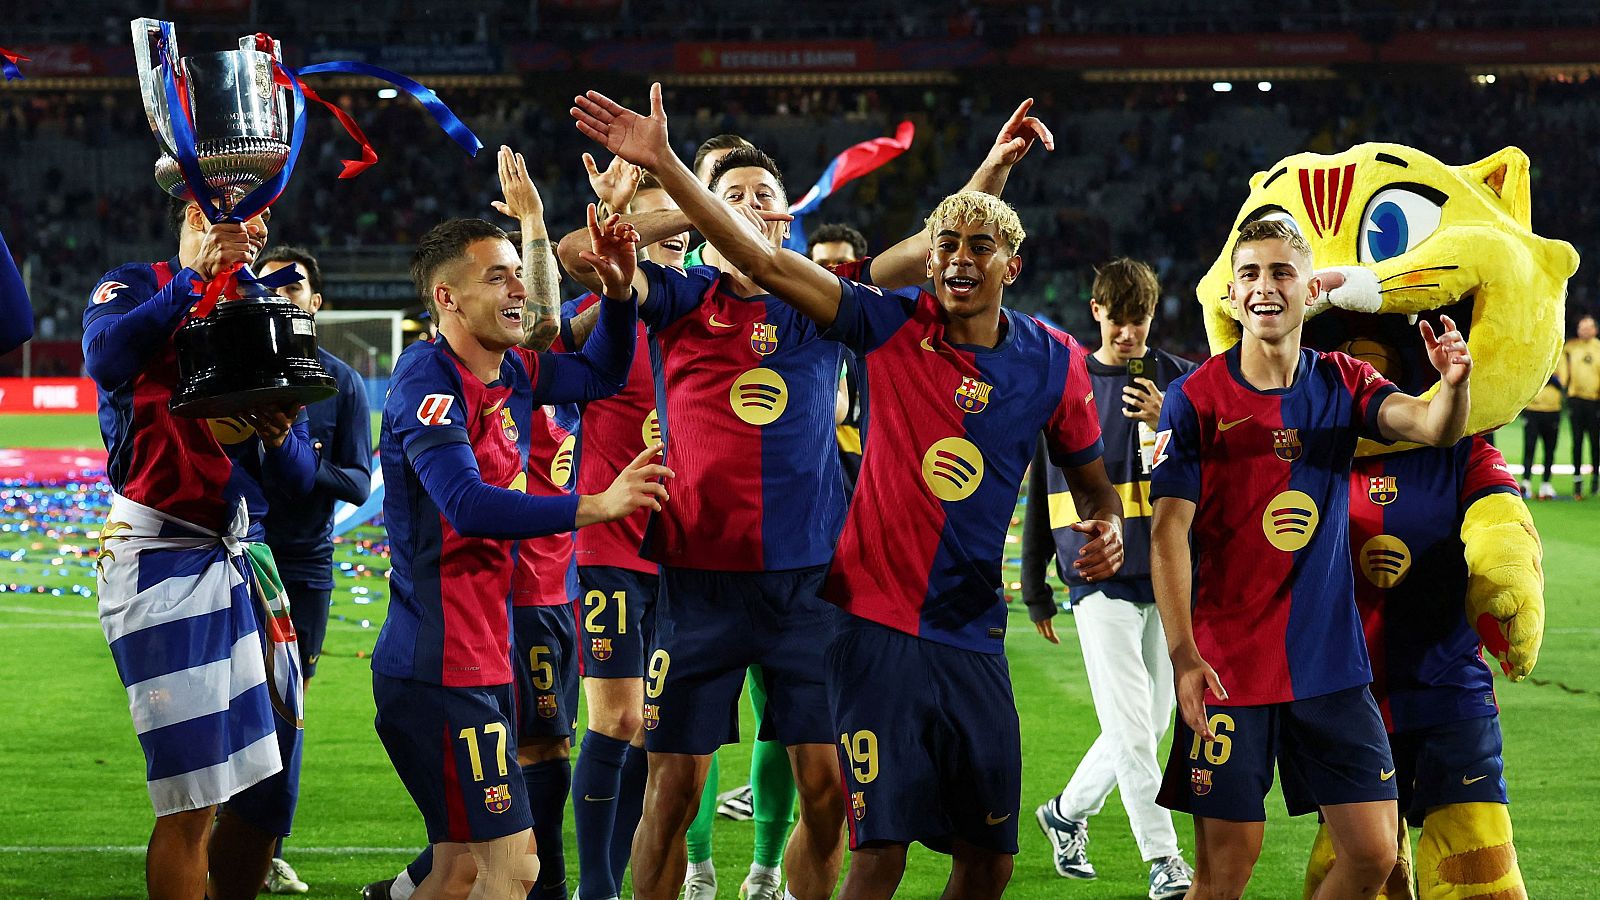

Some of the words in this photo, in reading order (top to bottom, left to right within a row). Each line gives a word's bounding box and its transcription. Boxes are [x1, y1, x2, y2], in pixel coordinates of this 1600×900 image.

[584, 589, 627, 635] 21
[529, 646, 553, 690] 5
[646, 649, 670, 699] 9
[458, 721, 508, 782] 17
[841, 729, 878, 784] 19
